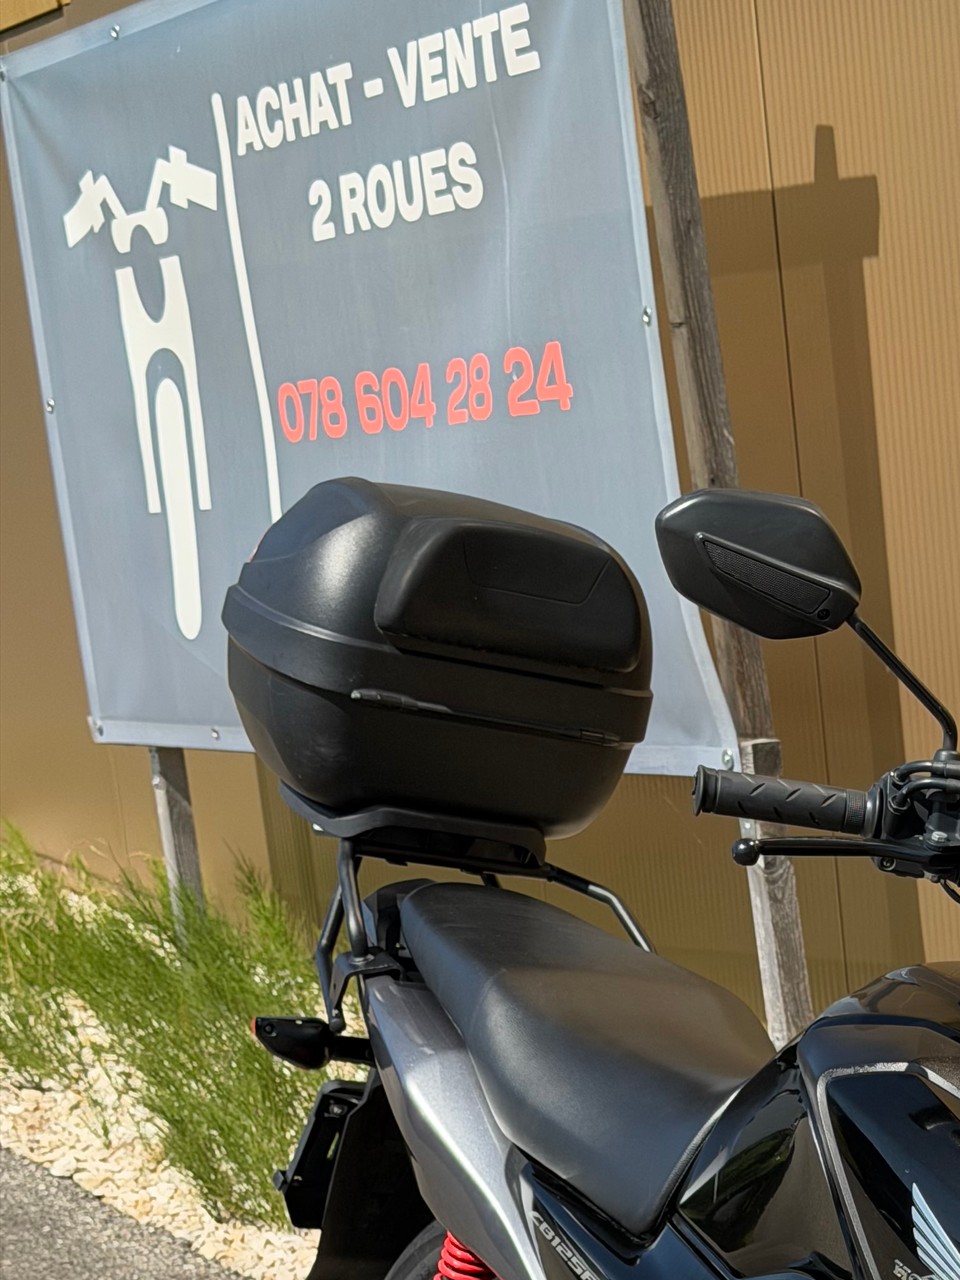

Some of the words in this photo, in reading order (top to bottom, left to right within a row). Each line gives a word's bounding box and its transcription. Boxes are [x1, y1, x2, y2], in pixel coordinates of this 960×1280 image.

[237, 62, 353, 156] ACHAT
[363, 78, 384, 98] -
[387, 2, 541, 108] VENTE
[308, 179, 336, 242] 2
[339, 141, 484, 235] ROUES
[278, 376, 347, 443] 078
[354, 363, 436, 434] 604
[446, 353, 493, 425] 28
[504, 341, 573, 417] 24
